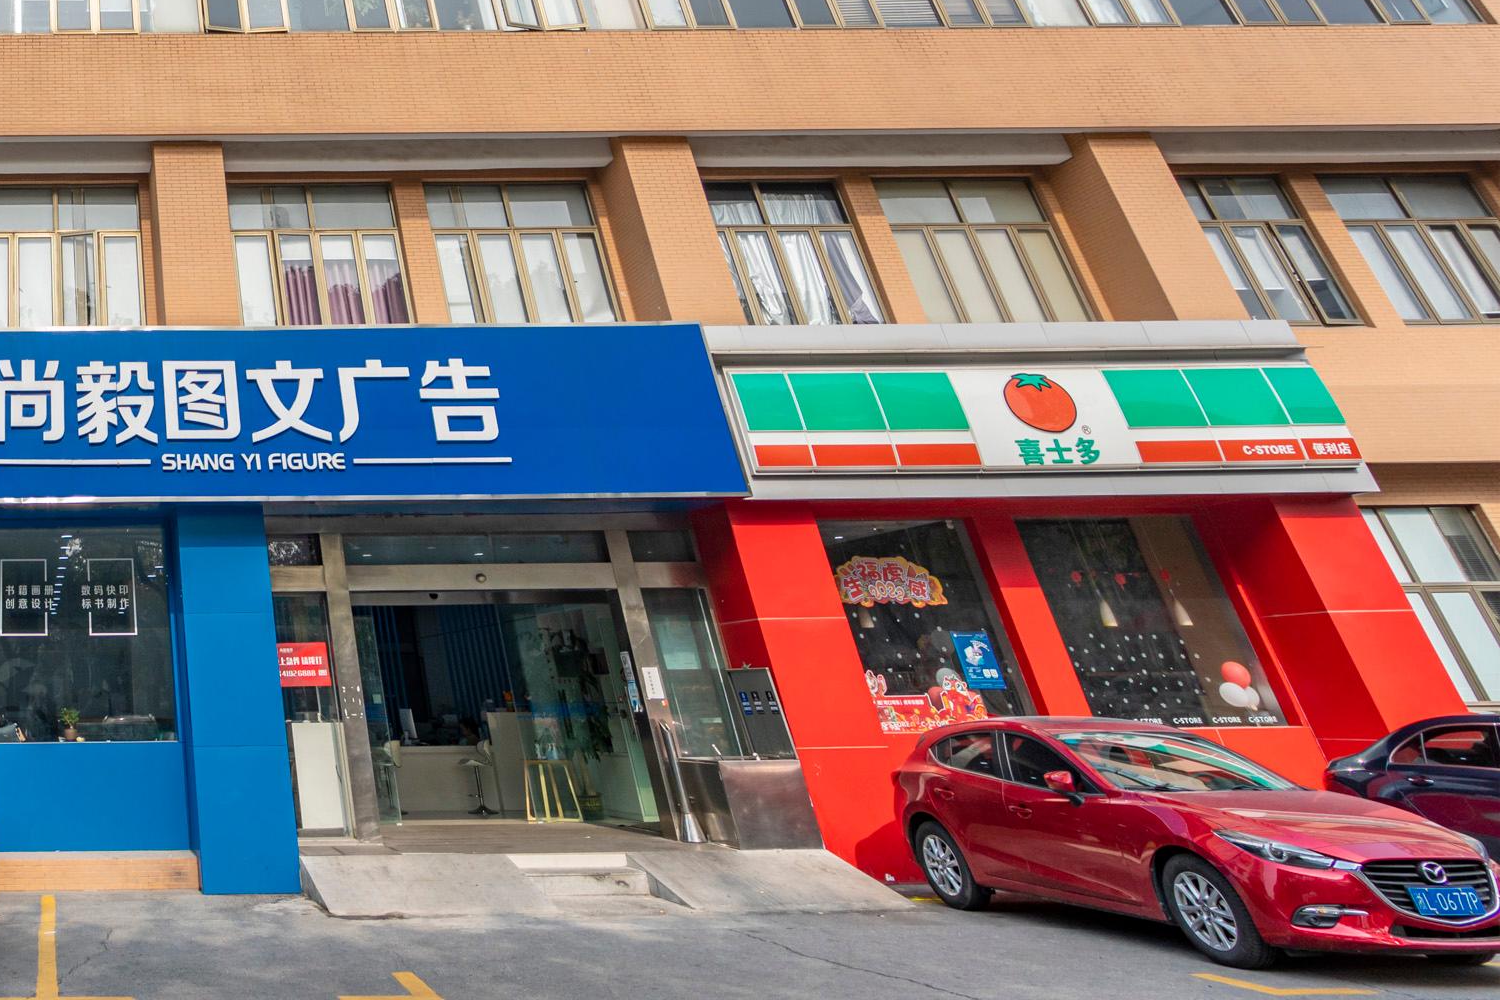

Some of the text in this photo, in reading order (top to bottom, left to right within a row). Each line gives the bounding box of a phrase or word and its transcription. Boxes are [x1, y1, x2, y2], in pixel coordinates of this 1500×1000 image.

[1014, 437, 1101, 466] 喜士多
[1242, 444, 1296, 456] C-STORE
[1312, 442, 1352, 456] 便利店
[161, 452, 347, 473] SHANG YI FIGURE
[5, 585, 54, 595] 书籍画册
[81, 585, 129, 595] 数码快印
[868, 580, 905, 601] 2022
[5, 598, 54, 609] 创意设计
[81, 598, 129, 609] 标书制作
[1212, 716, 1242, 724] C-STORE
[1248, 716, 1278, 724] C-STORE
